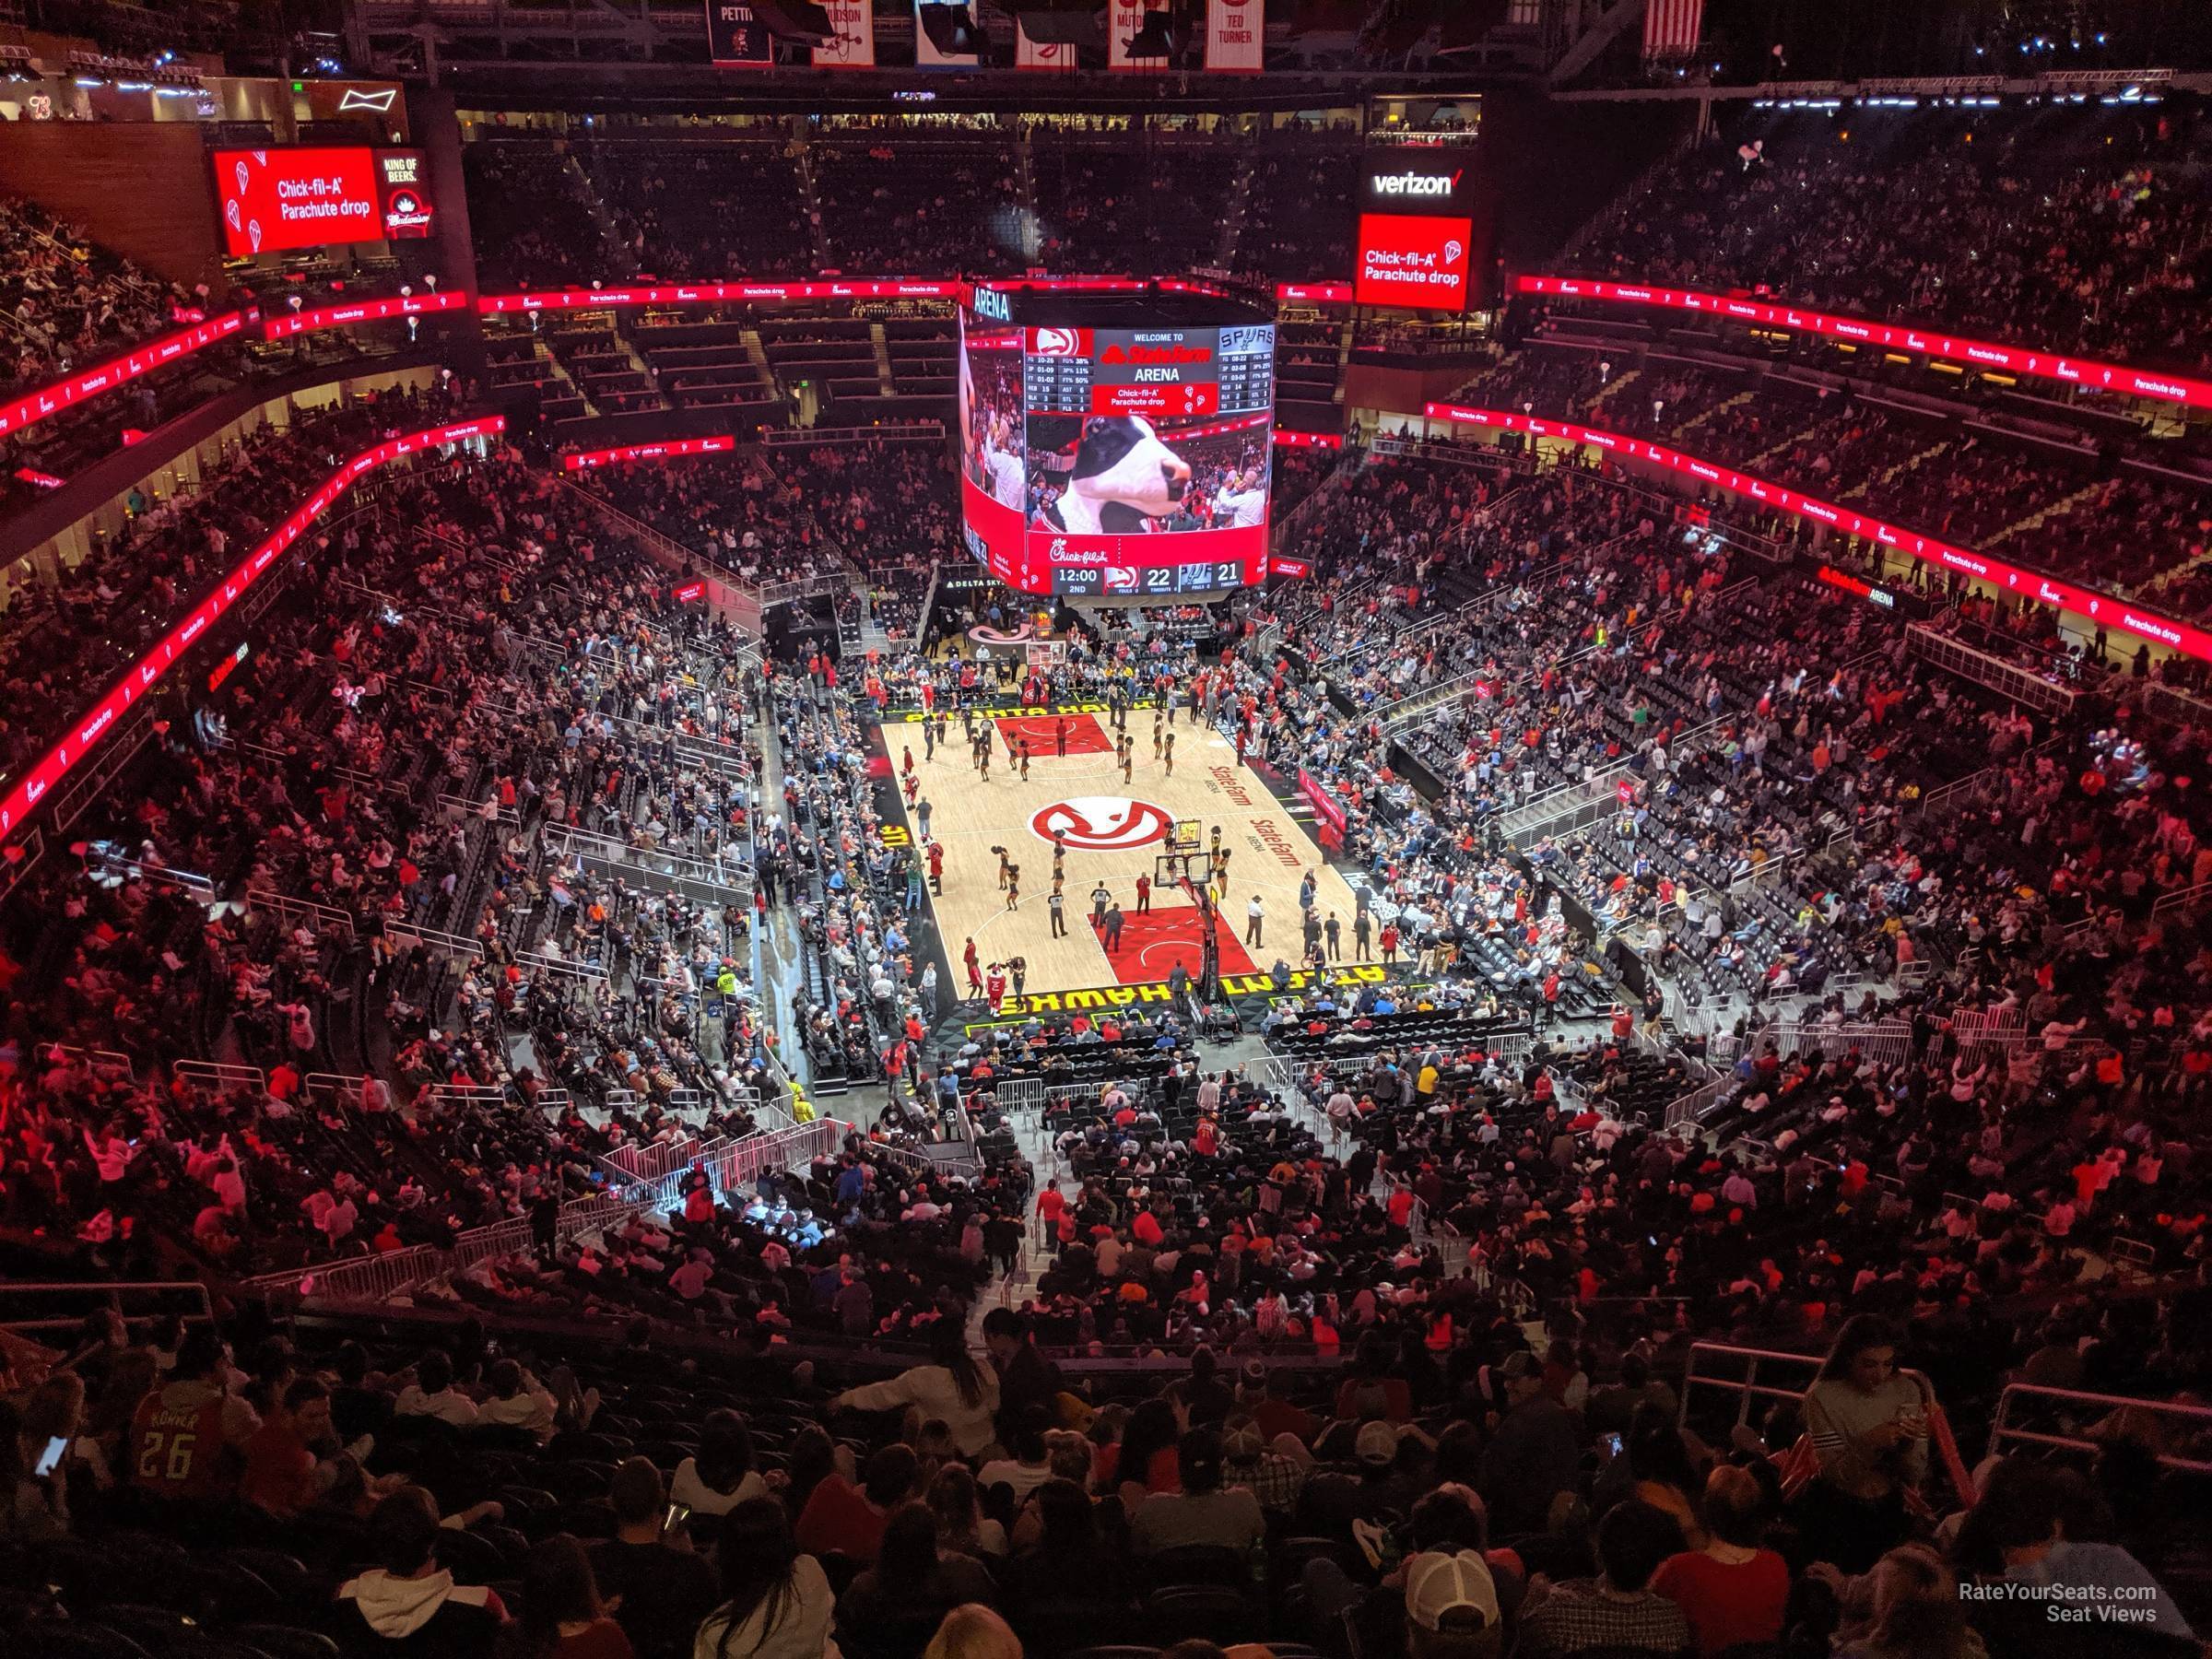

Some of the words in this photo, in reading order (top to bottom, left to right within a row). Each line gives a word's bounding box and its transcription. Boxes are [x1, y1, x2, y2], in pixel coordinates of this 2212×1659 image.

[1227, 15, 1243, 28] TED
[1218, 30, 1252, 44] TURNER
[384, 159, 405, 171] KING
[406, 159, 418, 171] OF
[388, 171, 417, 182] BEERS.
[1374, 171, 1452, 194] verizon
[281, 199, 338, 220] Parachute
[340, 198, 371, 219] drop
[1365, 266, 1427, 282] Parachute
[1429, 270, 1460, 288] drop
[974, 287, 1010, 322] ARENA
[1135, 333, 1172, 342] WELCOME
[1174, 333, 1183, 341] TO
[1221, 327, 1274, 351] SPURS
[1135, 368, 1180, 382] ARENA
[1148, 398, 1165, 406] drop
[1060, 569, 1098, 582] 12:00
[1147, 569, 1171, 586] 22
[1218, 563, 1238, 581] 21
[1069, 585, 1086, 594] 2ND
[1870, 588, 1894, 607] ARENA
[2124, 615, 2161, 636] Parachute
[2161, 628, 2182, 643] drop
[1246, 835, 1266, 853] ARENA
[139, 1431, 196, 1479] 26
